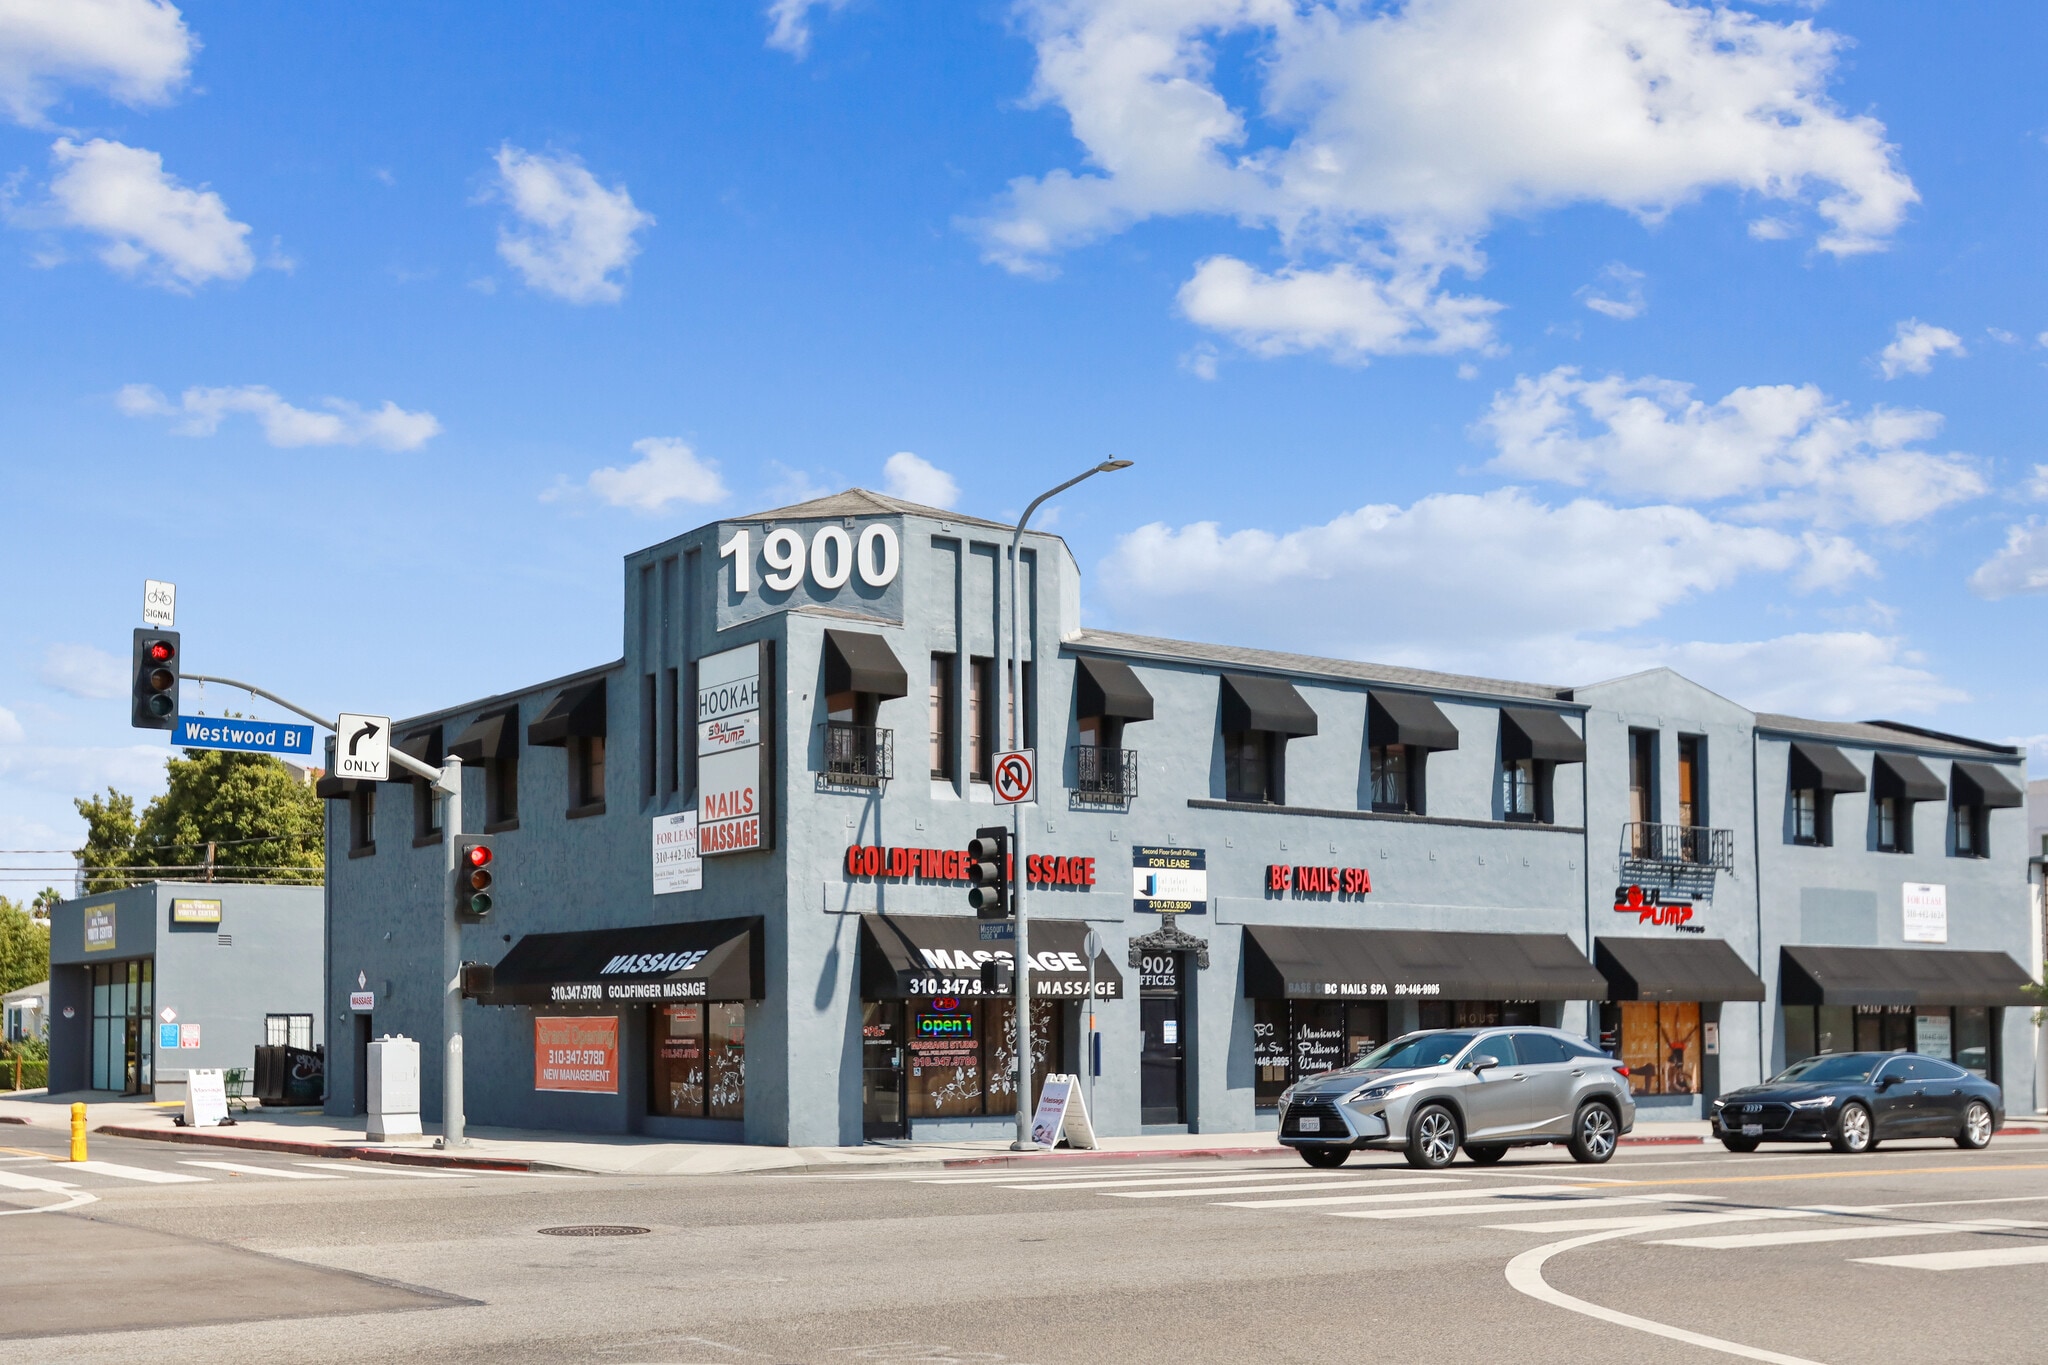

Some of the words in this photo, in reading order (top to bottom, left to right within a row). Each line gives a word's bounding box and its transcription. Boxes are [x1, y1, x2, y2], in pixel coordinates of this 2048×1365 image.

[720, 523, 900, 593] 1900
[145, 608, 172, 621] SIGNAL
[699, 679, 760, 717] HOOKAH
[185, 722, 276, 746] Westwood
[284, 731, 301, 748] Bl
[708, 729, 745, 745] PUMP
[344, 759, 380, 773] ONLY
[705, 787, 754, 820] NAILS
[656, 831, 672, 846] FOR
[674, 827, 697, 843] LEASE
[700, 818, 758, 853] MASSAGE
[655, 847, 698, 864] 310-442-162
[1182, 849, 1197, 857] Offices
[847, 844, 978, 880] GOLDFINGE
[1149, 858, 1165, 868] FOR
[1166, 859, 1190, 868] LEASE
[1270, 864, 1292, 890] BC
[1298, 866, 1340, 893] NAILS
[1344, 867, 1372, 893] SPA
[1149, 900, 1191, 910] 310.470.9350
[198, 910, 219, 918] CENTER
[980, 924, 1004, 933] Missouri
[1006, 924, 1014, 933] Av
[600, 949, 709, 975] MASSAGE
[1142, 956, 1175, 974] 902
[909, 977, 1009, 996] 310.347.9
[1037, 981, 1116, 995] MASSAGE
[1139, 974, 1176, 986] FFICES
[551, 983, 602, 1000] 310.347.9780
[608, 984, 661, 999] GOLDFINGER
[663, 981, 706, 997] MASSAGE
[1324, 983, 1338, 995] BC
[1340, 983, 1368, 995] NAILS
[1370, 983, 1388, 995] SPA
[1394, 983, 1440, 995] 310-446-9995
[922, 1019, 962, 1036] open
[1253, 1022, 1274, 1037] BC
[1297, 1023, 1342, 1040] Manicure
[538, 1026, 571, 1045] Grand
[572, 1026, 615, 1049] Opening
[911, 1041, 949, 1050] MASSAGE
[950, 1040, 978, 1049] STUDIO
[1268, 1041, 1284, 1054] Spa
[1298, 1040, 1340, 1055] Pedicure
[548, 1050, 605, 1065] 310-347-9780
[912, 1056, 977, 1067] 310.347.9780
[1298, 1055, 1333, 1071] Waxing
[543, 1069, 559, 1081] NEW
[559, 1069, 611, 1082] MANAGEMENT
[1043, 1096, 1065, 1106] Massage
